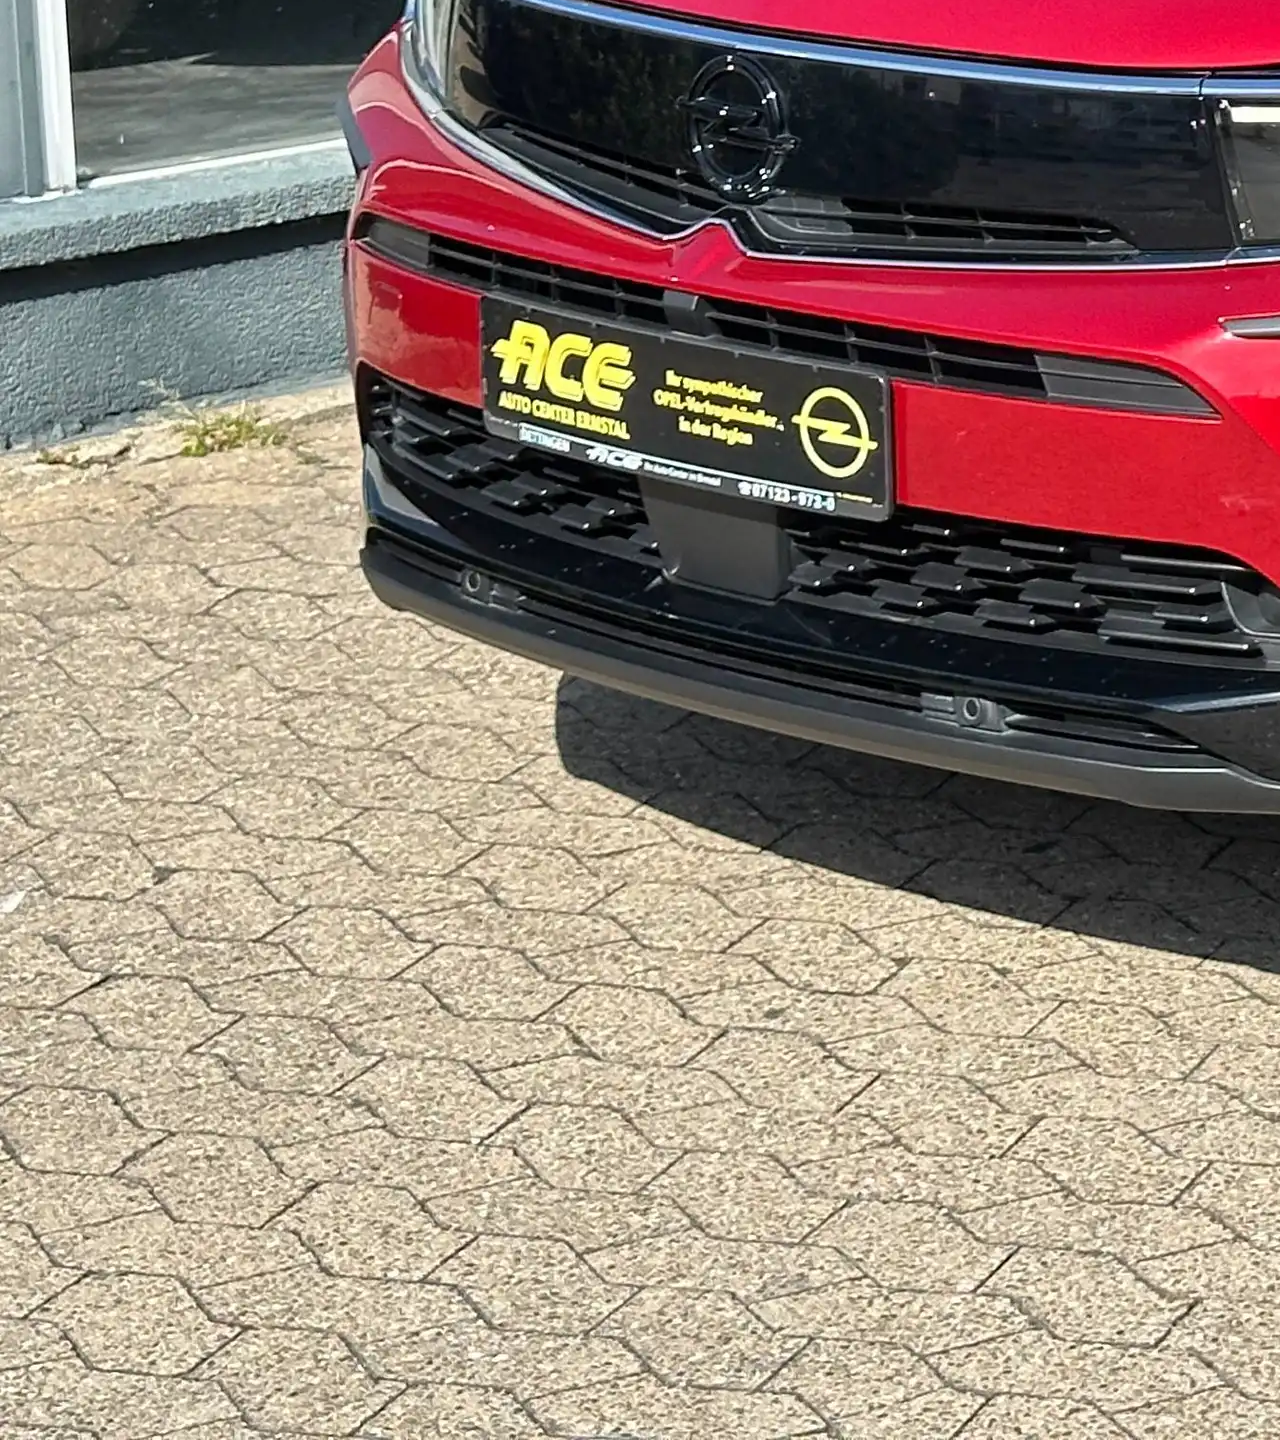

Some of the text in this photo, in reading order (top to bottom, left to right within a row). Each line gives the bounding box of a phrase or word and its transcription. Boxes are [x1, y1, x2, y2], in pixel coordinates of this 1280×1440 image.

[490, 320, 636, 411] ACE
[498, 391, 531, 414] AUTO
[532, 399, 575, 426] CENTER
[678, 415, 691, 433] in
